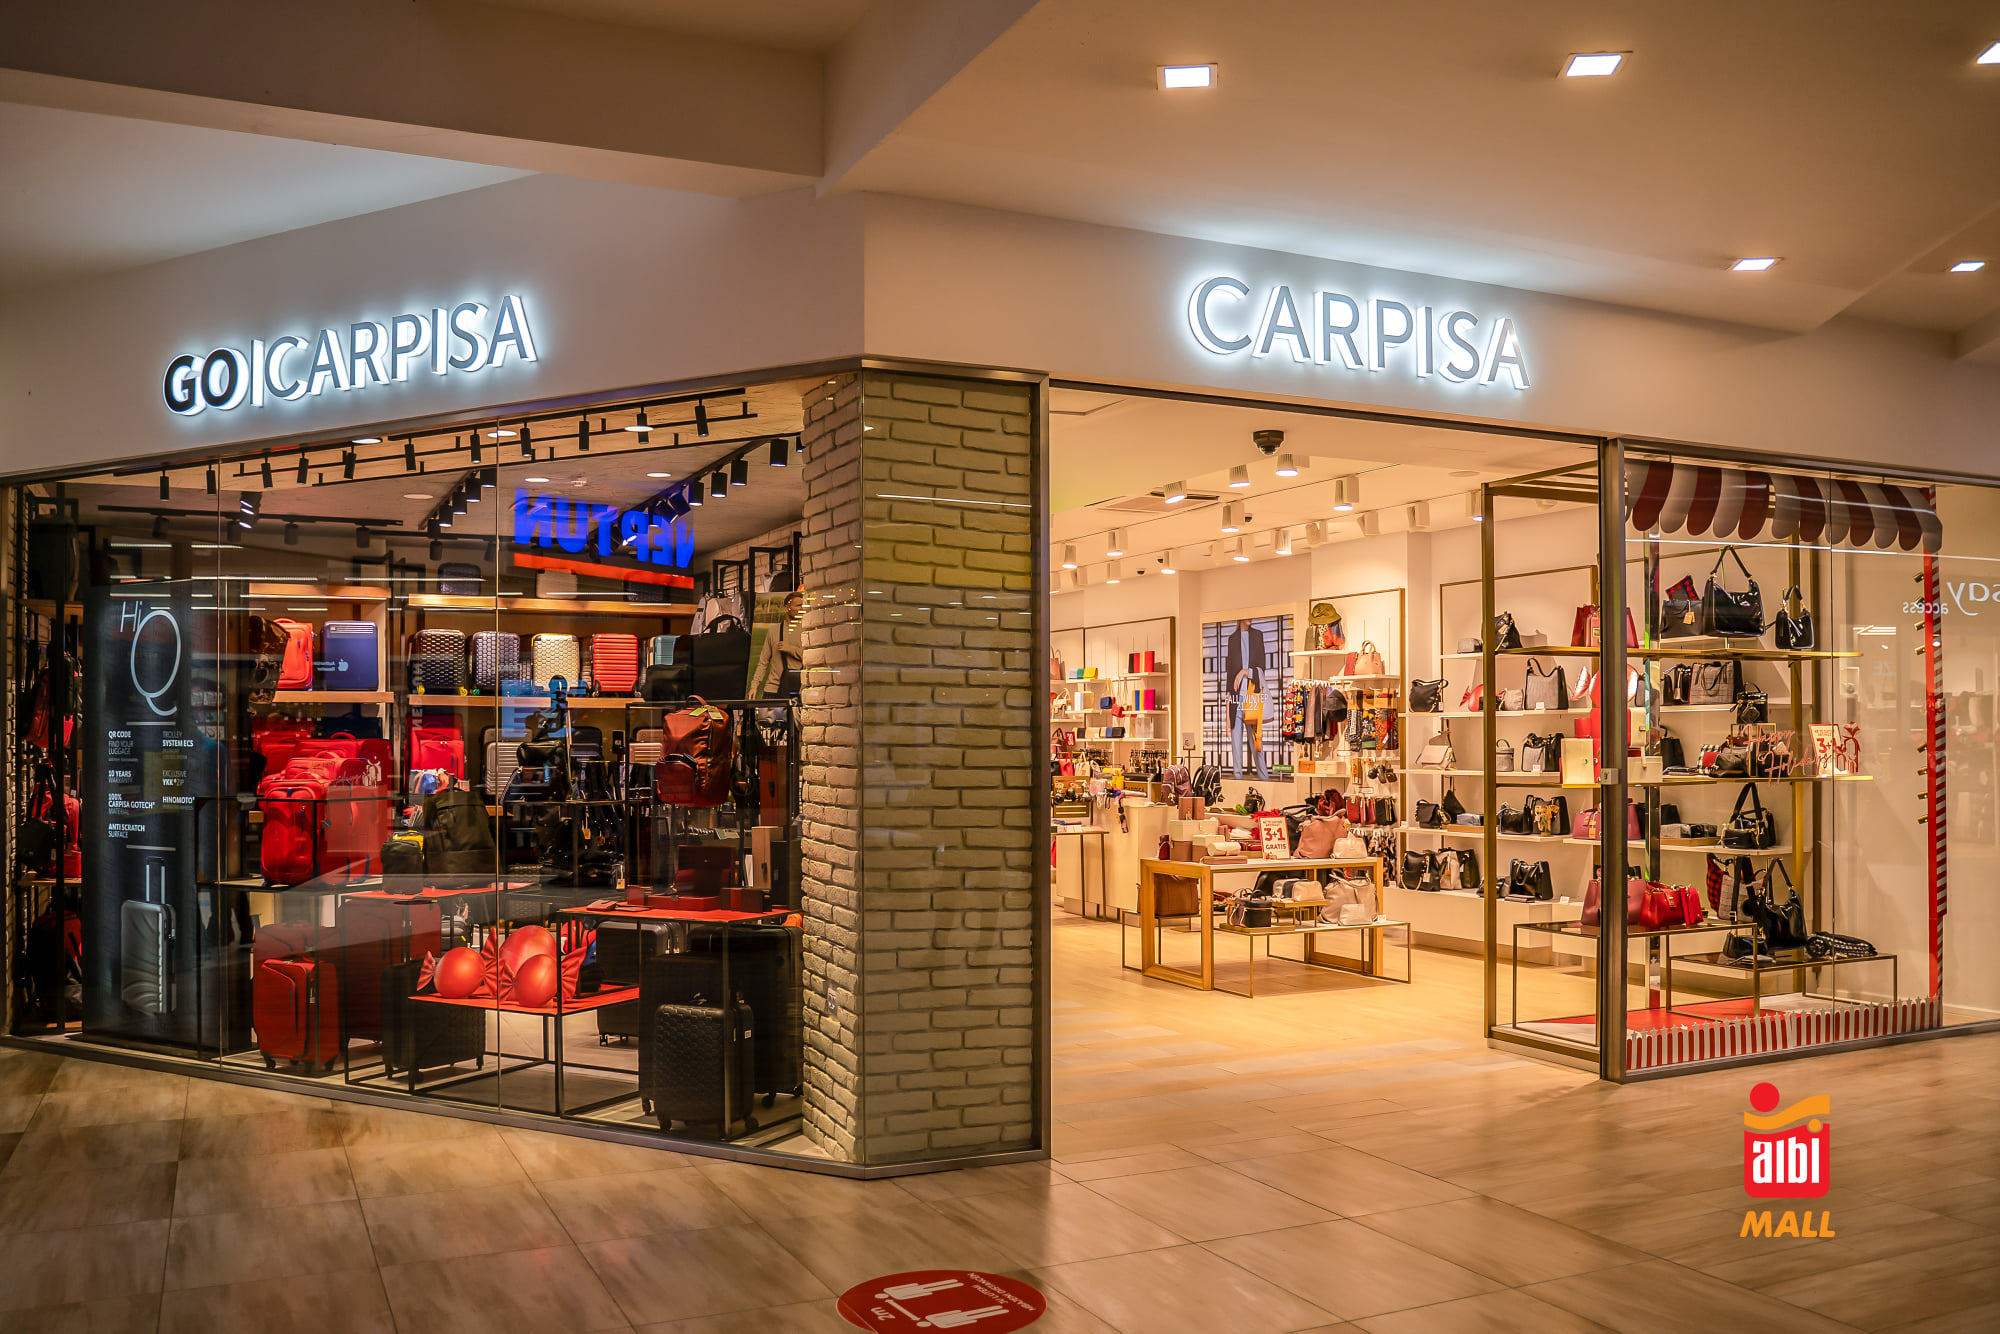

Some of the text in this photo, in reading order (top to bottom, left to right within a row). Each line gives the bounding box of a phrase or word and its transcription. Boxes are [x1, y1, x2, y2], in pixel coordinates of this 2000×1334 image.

[1187, 276, 1532, 391] CARPISA
[1224, 693, 1269, 704] FALL WINTER
[108, 730, 132, 740] QR CODE
[162, 739, 183, 747] SYSTEM
[1740, 723, 1795, 760] Happy
[116, 770, 132, 778] YEARS
[108, 801, 131, 809] CARPISA
[108, 823, 146, 832] ANTI SCRATCH
[108, 830, 129, 839] SURFACE
[1263, 827, 1286, 841] 3+1
